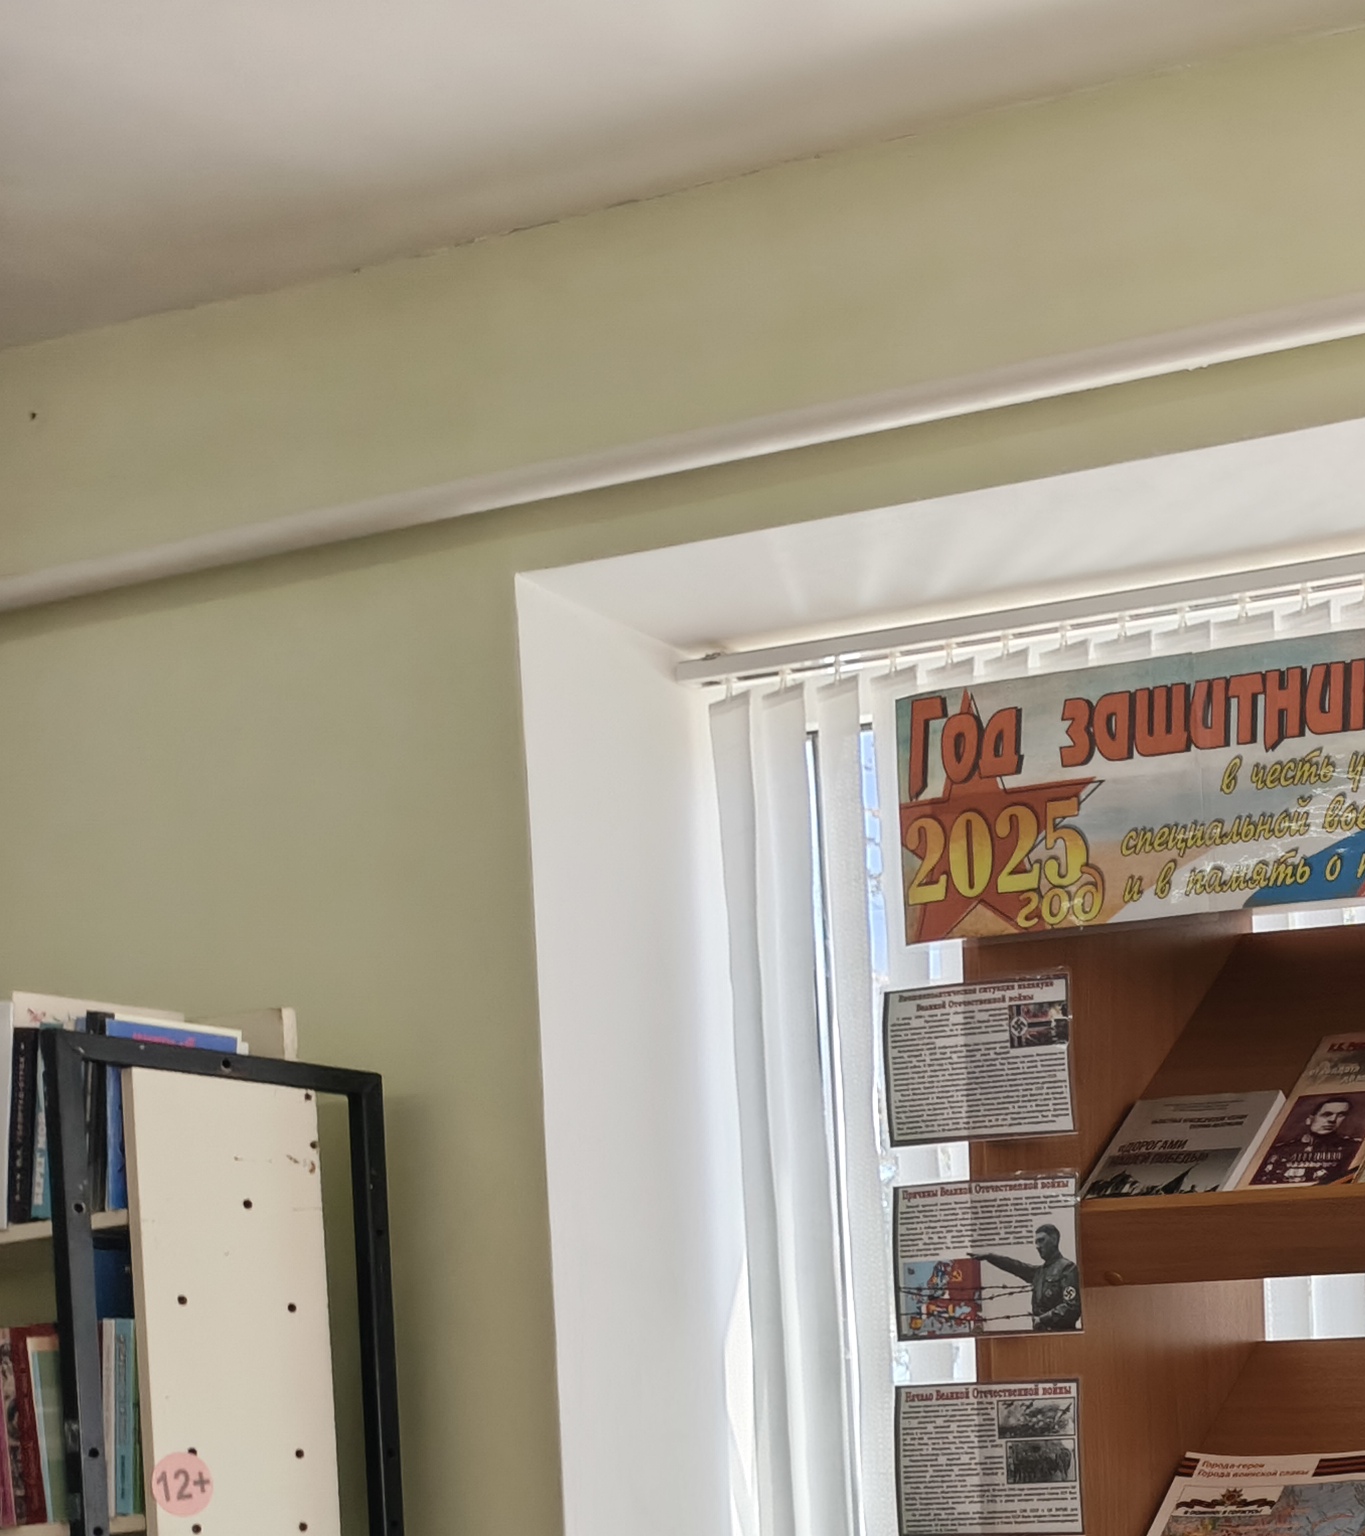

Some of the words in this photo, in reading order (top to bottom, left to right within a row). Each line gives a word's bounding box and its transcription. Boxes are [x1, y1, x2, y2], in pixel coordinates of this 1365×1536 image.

[908, 694, 1024, 801] Год
[1220, 751, 1245, 795] в
[1250, 747, 1334, 791] честь
[906, 798, 1089, 906] 2025
[1120, 796, 1312, 857] специальной
[1018, 865, 1106, 929] год
[1123, 874, 1143, 904] и
[1154, 859, 1176, 899] в
[1184, 850, 1312, 898] память
[1324, 853, 1343, 882] о
[902, 1188, 939, 1203] Причины
[940, 1185, 973, 1198] Великой
[974, 1181, 1039, 1196] Отечественной
[905, 1391, 934, 1403] Начало
[935, 1388, 971, 1402] Великой
[972, 1385, 1041, 1399] Отечественной
[1042, 1383, 1072, 1396] войны
[155, 1466, 212, 1503] 12+
